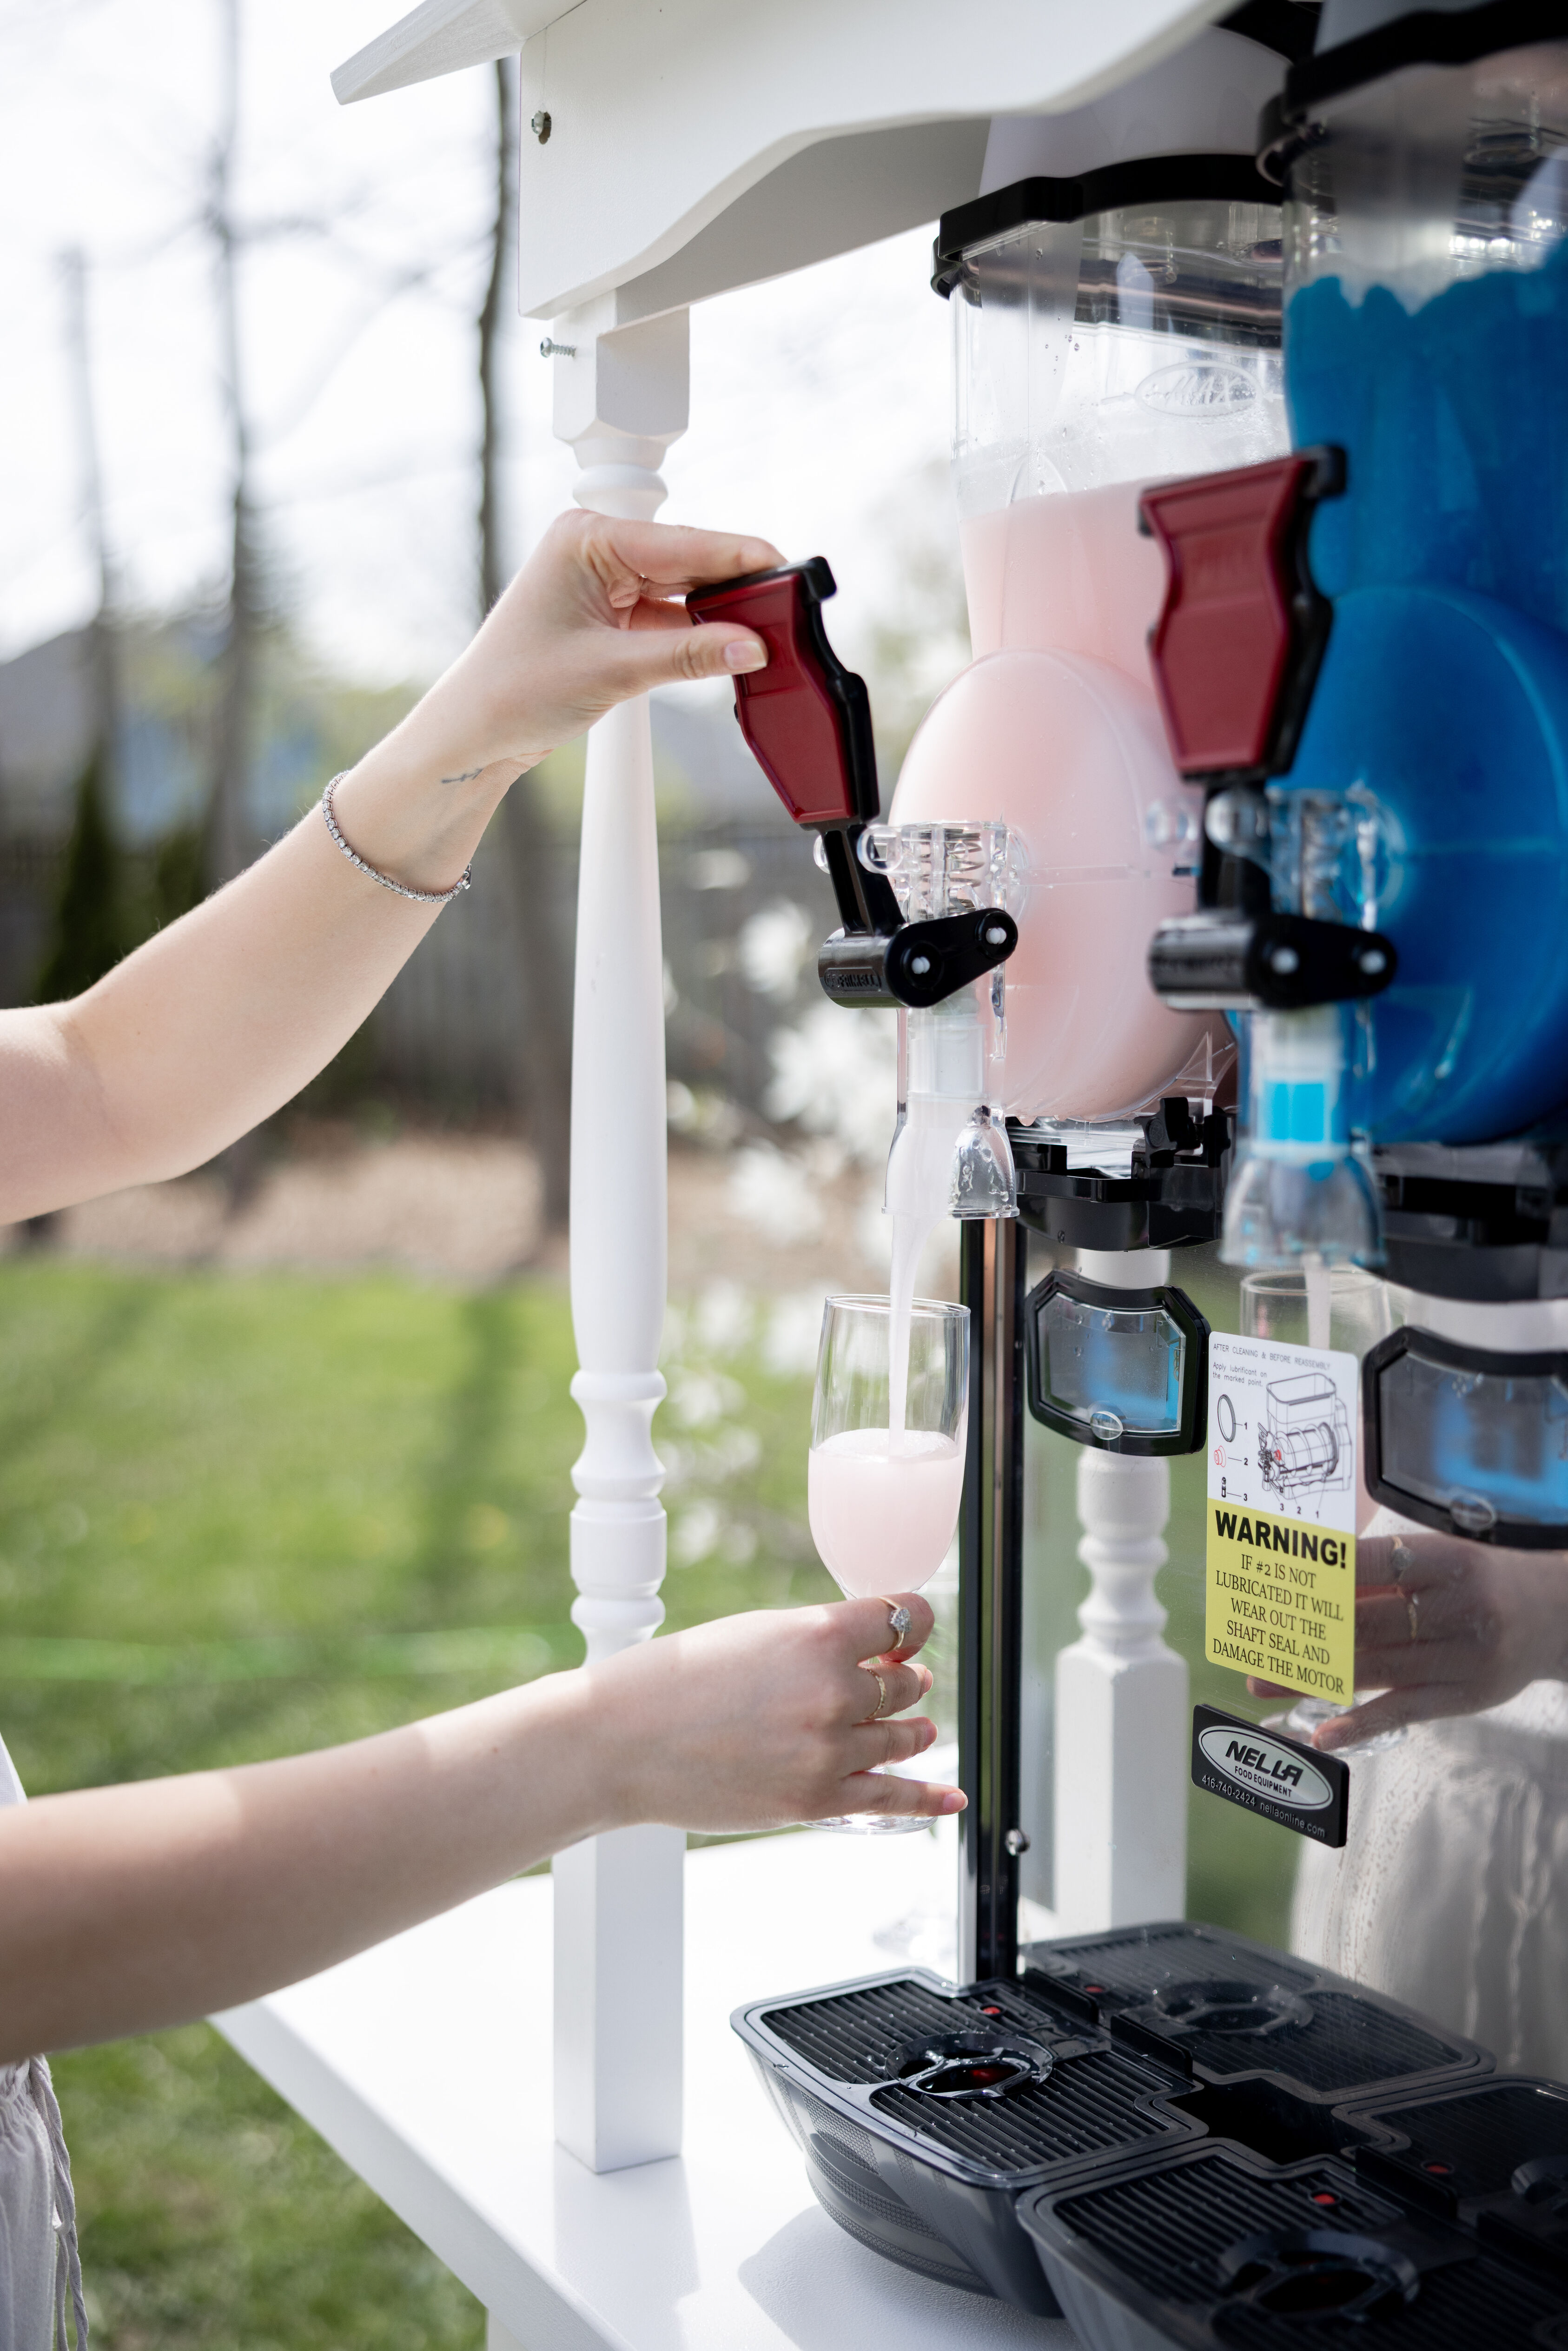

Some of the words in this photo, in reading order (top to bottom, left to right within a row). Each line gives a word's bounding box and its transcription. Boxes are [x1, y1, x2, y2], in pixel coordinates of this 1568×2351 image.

[1213, 1344, 1229, 1353] AFTER
[1232, 1346, 1258, 1358] CLEANING
[1270, 1353, 1291, 1364] BEFORE
[1294, 1357, 1331, 1371] REASSEMBLY
[1213, 1362, 1226, 1372] Apply
[1230, 1364, 1257, 1377] lubrificant
[1224, 1374, 1245, 1384] marked
[1248, 1377, 1263, 1388] point.
[1280, 1503, 1284, 1511] 3
[1215, 1510, 1346, 1570] WARNING!
[1241, 1554, 1252, 1570] IF
[1257, 1561, 1271, 1576] #2
[1275, 1563, 1285, 1580] IS
[1290, 1567, 1316, 1589] NOT
[1216, 1570, 1292, 1606] LUBRICATED
[1295, 1593, 1308, 1610] IT
[1311, 1597, 1343, 1622] WILL
[1231, 1598, 1267, 1623] WEAR
[1270, 1609, 1297, 1630] OUT
[1299, 1618, 1326, 1641] THE
[1227, 1620, 1266, 1645] SHAFT
[1269, 1633, 1299, 1656] SEAL
[1302, 1644, 1330, 1665] AND
[1213, 1638, 1264, 1669] DAMAGE
[1267, 1656, 1293, 1678] THE
[1297, 1665, 1345, 1695] MOTOR
[1225, 1740, 1303, 1787] NELLA
[1235, 1765, 1252, 1781] FOOD
[1254, 1774, 1292, 1798] EQUIPMENT
[1202, 1774, 1256, 1807] 416-740-2424
[1260, 1801, 1325, 1838] nellaonline.com
